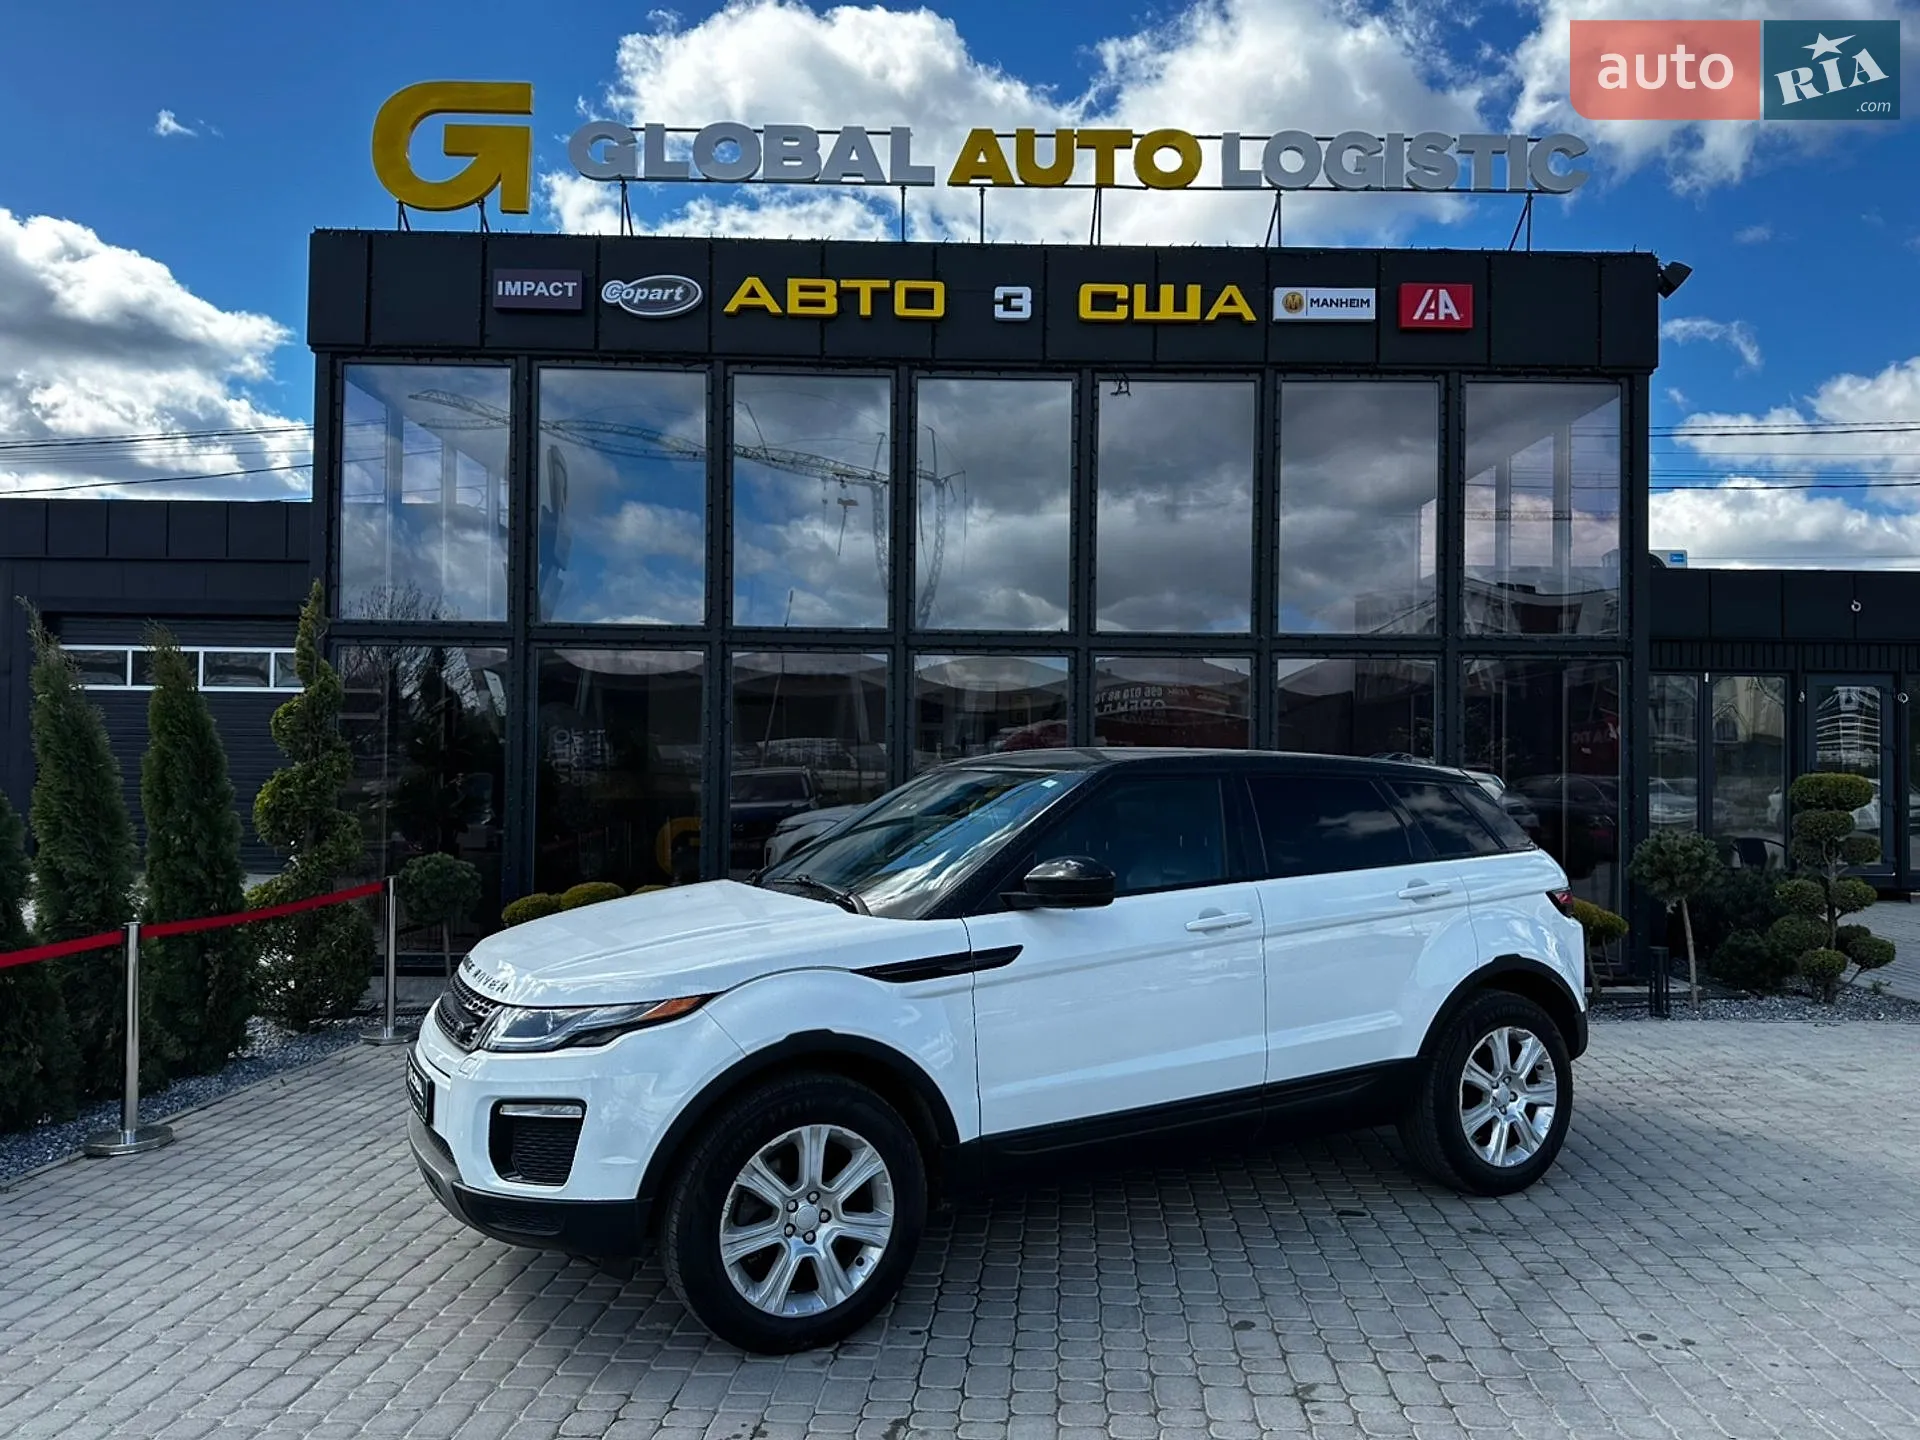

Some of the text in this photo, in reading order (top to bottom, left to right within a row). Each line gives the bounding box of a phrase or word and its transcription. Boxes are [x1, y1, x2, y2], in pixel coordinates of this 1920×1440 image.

[567, 120, 1591, 194] GLOBAL AUTO LOGISTIC
[497, 280, 578, 297] IMPACT
[604, 283, 686, 304] Copart
[724, 276, 947, 320] АВТО
[1078, 282, 1258, 324] США
[1309, 298, 1371, 309] MANHEIM
